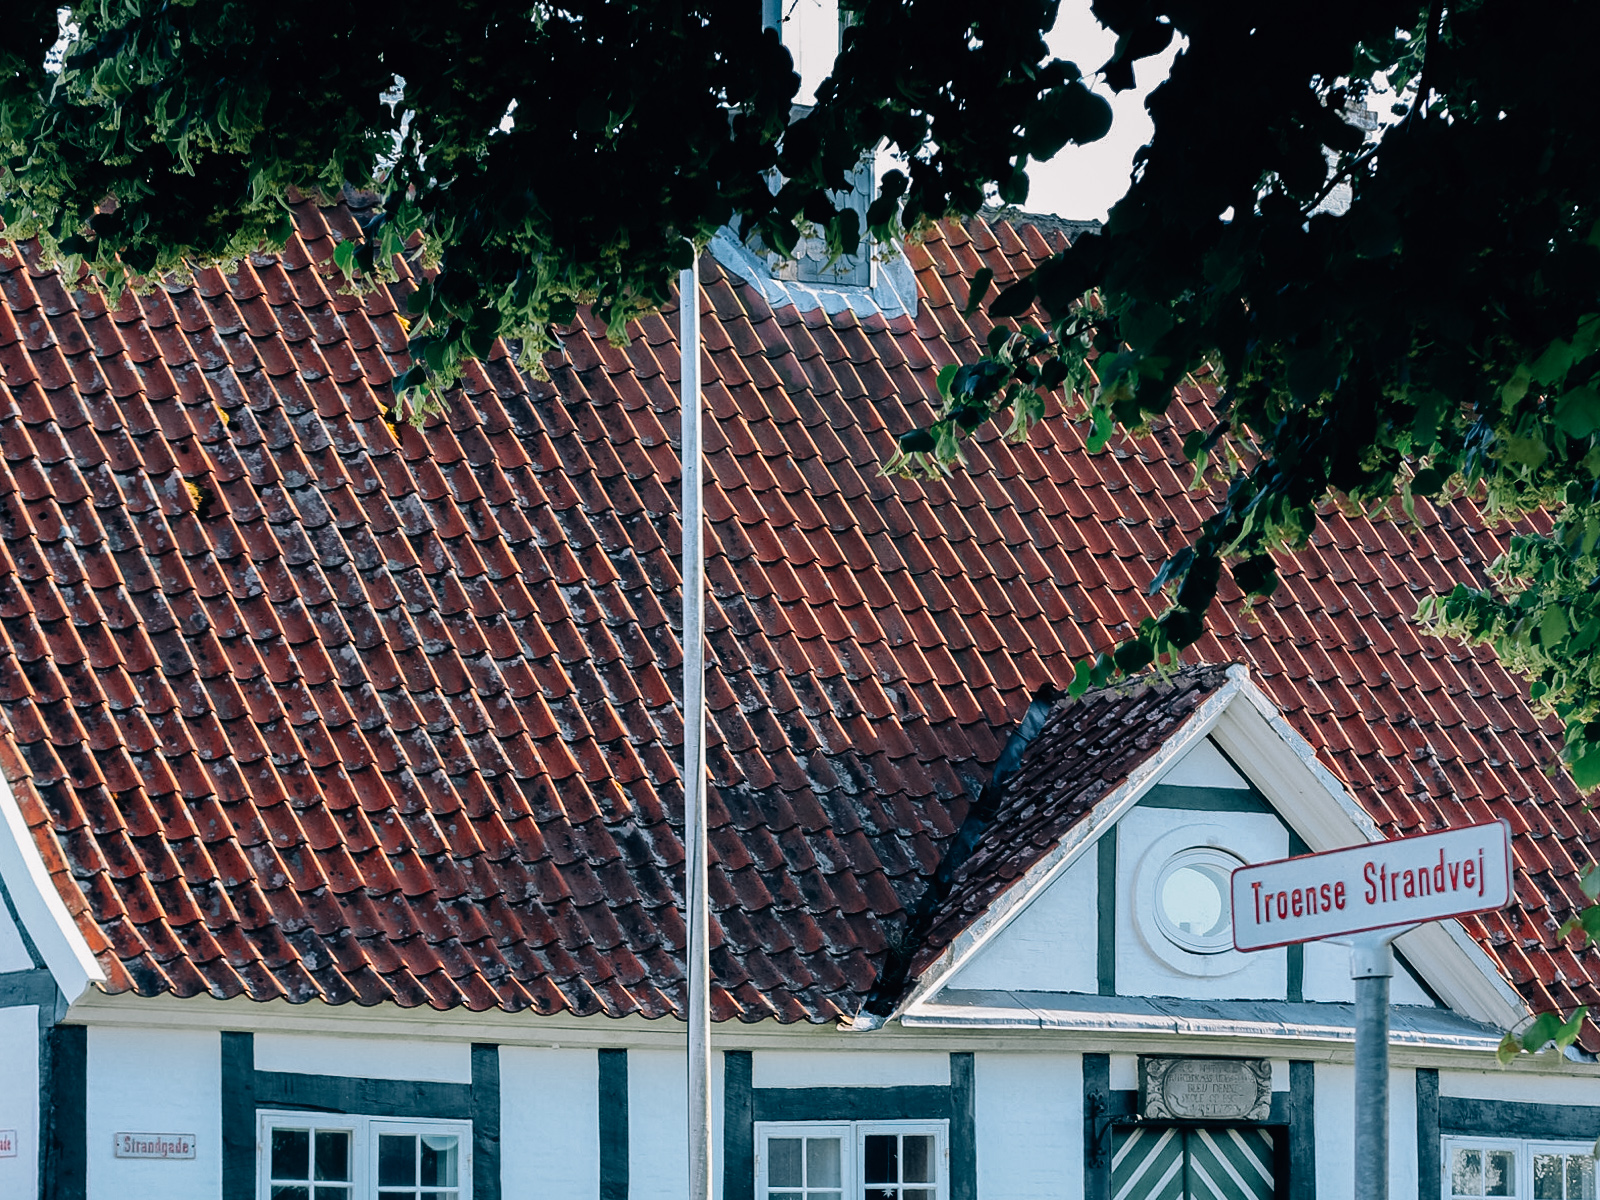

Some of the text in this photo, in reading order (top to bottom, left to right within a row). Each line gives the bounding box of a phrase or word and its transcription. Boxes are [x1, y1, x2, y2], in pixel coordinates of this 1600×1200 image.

[1251, 847, 1485, 925] Troense Strandvej
[124, 1135, 189, 1157] Strandgade
